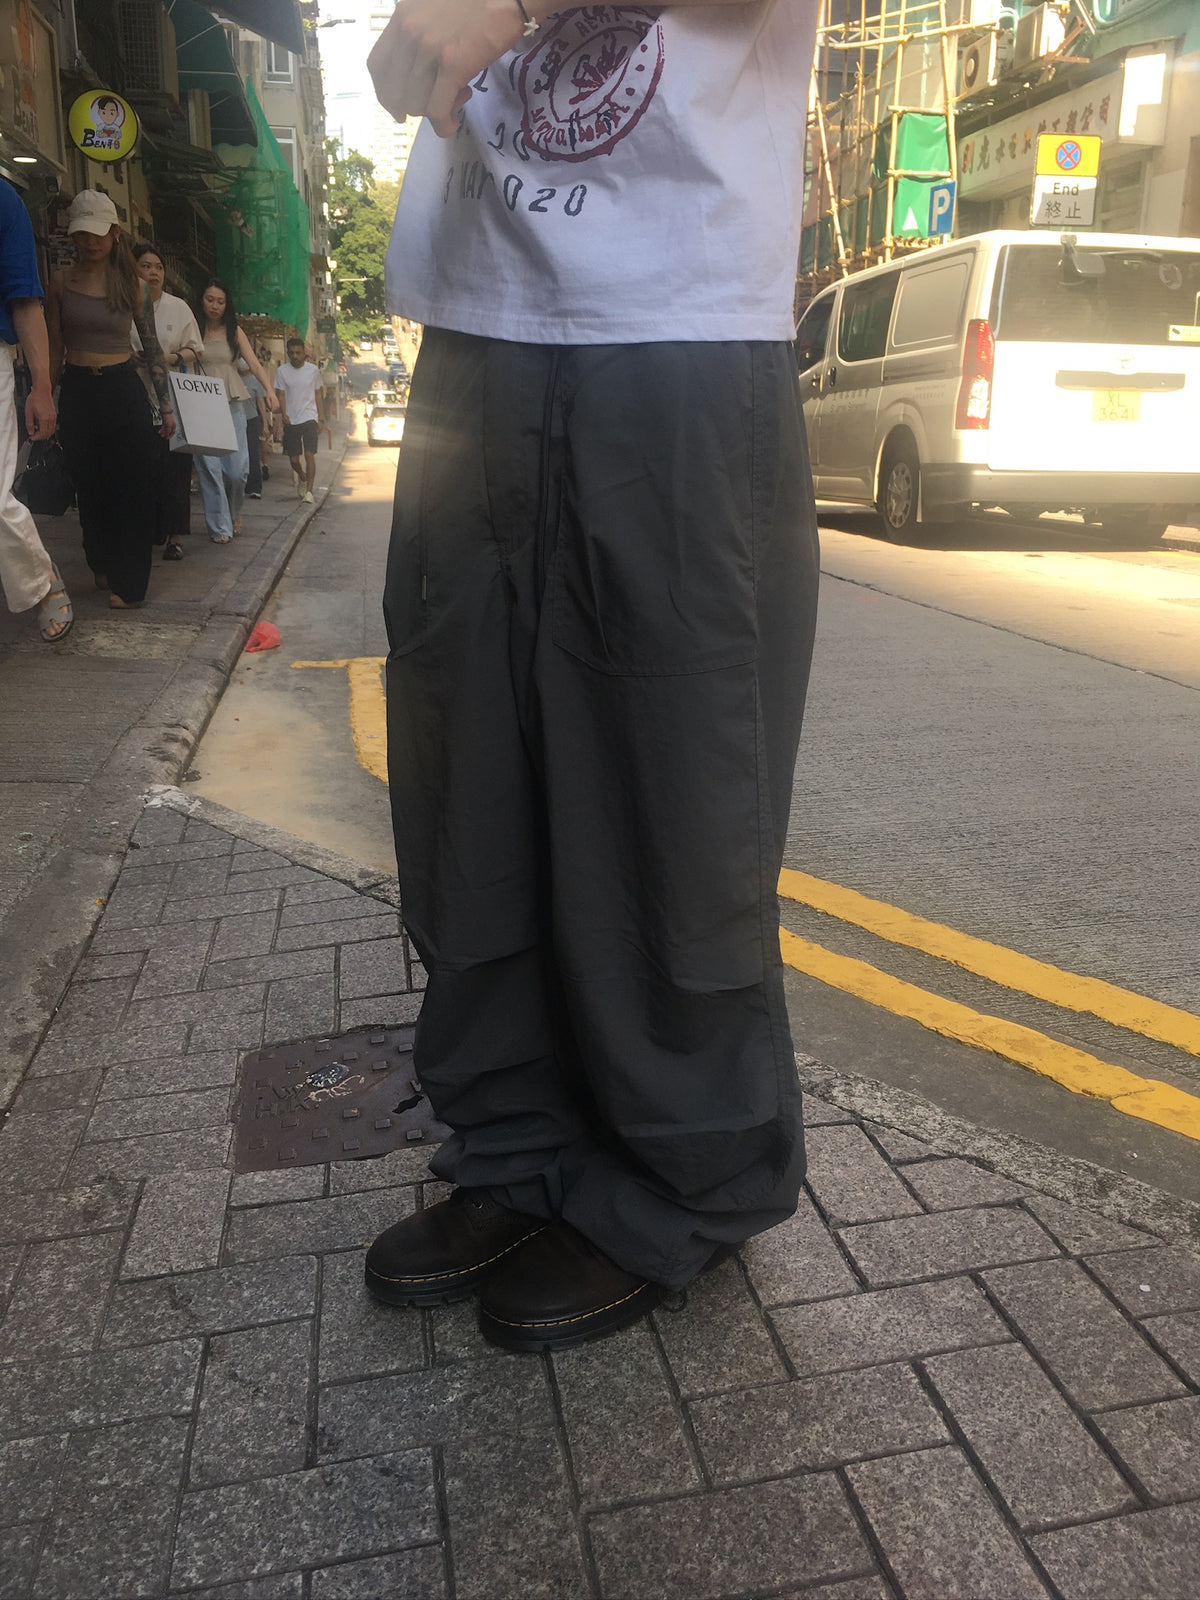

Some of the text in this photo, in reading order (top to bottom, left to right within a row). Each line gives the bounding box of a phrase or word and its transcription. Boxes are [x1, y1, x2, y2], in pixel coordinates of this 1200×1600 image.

[1053, 182, 1080, 196] End
[931, 188, 951, 231] P
[1045, 201, 1082, 219] 終止
[176, 378, 222, 395] LOEWE
